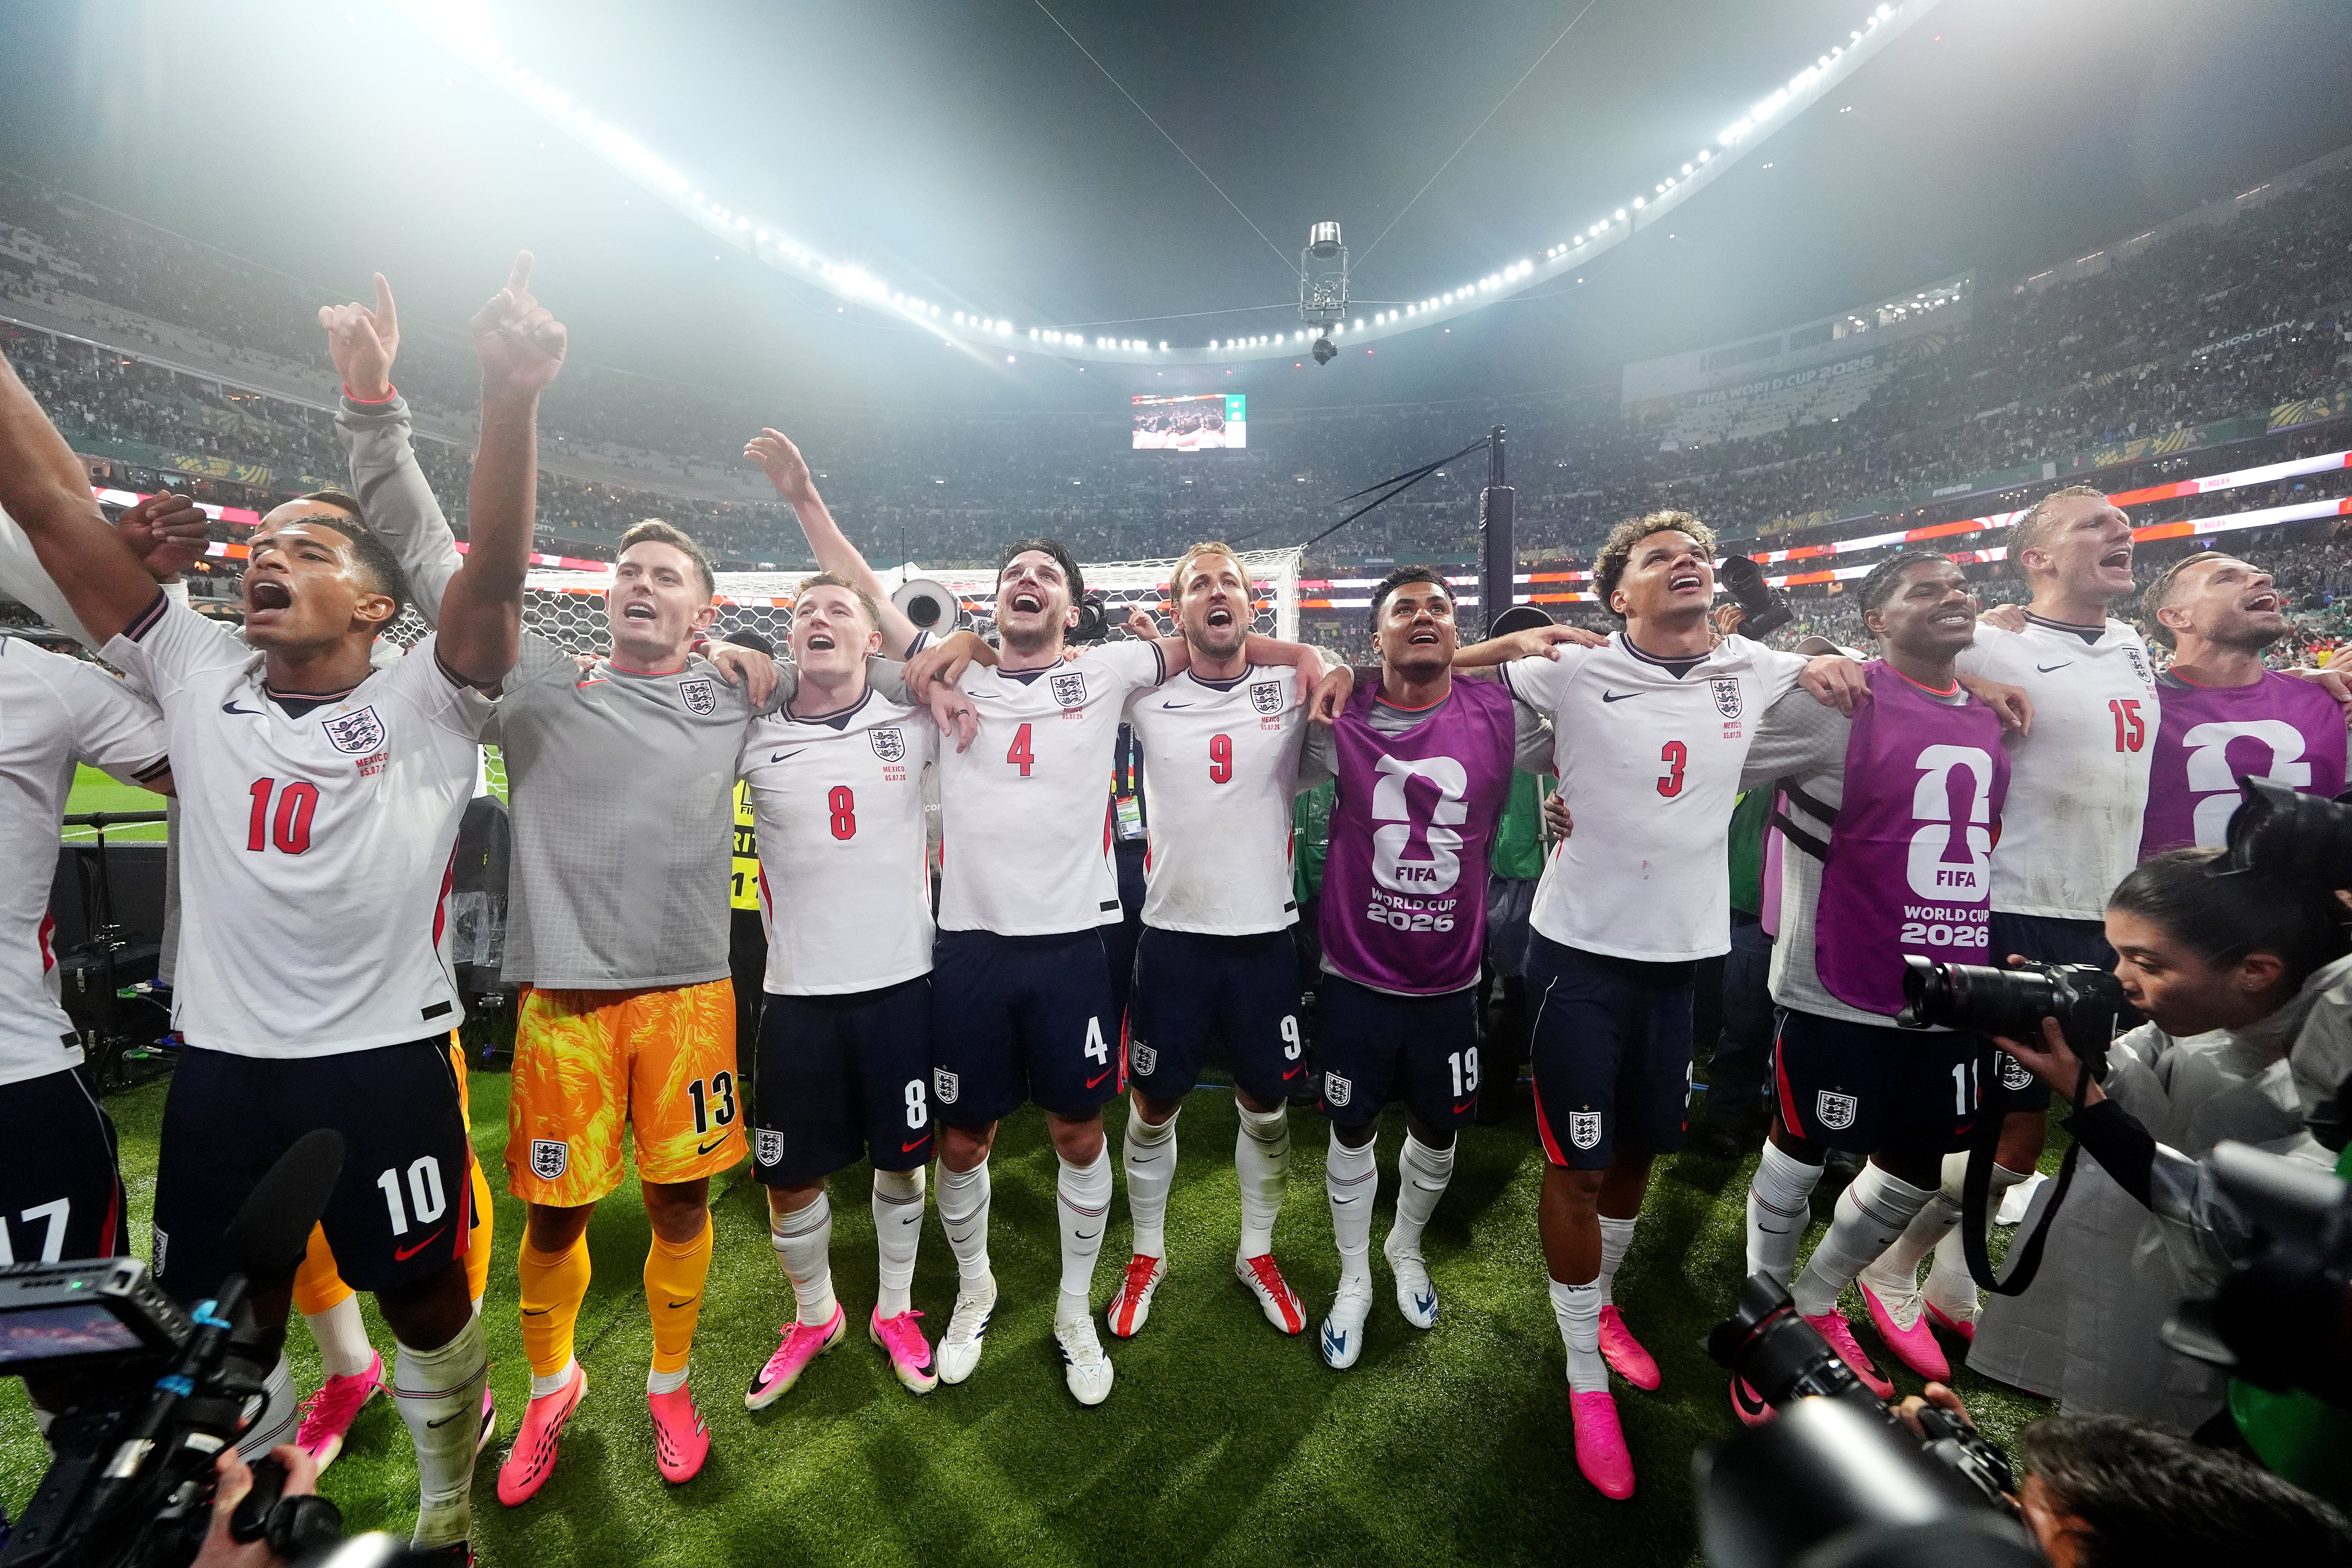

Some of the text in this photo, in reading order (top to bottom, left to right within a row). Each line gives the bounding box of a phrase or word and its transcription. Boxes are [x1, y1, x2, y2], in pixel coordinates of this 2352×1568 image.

[2191, 319, 2296, 357] MEXICO CITY
[1697, 356, 1875, 405] FIFA WORLD CUP 2026
[2204, 477, 2230, 488] ENGLAN
[1007, 723, 1034, 776] 4
[2109, 700, 2144, 752] 15
[355, 753, 388, 768] MEXICO
[1210, 734, 1232, 784] 9
[1657, 740, 1687, 797] 3
[247, 777, 319, 854] 10
[828, 786, 856, 840] 8
[1372, 887, 1457, 911] WORLD CUP
[1396, 867, 1437, 882] FIFA
[1936, 870, 1976, 887] FIFA
[1367, 903, 1454, 932] 2026
[1900, 923, 1989, 947] 2026
[1904, 905, 1989, 922] WORLD CUP
[1084, 1016, 1107, 1065] 4
[1280, 1014, 1301, 1061] 9
[1448, 1046, 1477, 1097] 19
[687, 1070, 736, 1136] 13
[904, 1078, 927, 1130] 8
[377, 1155, 446, 1236] 10
